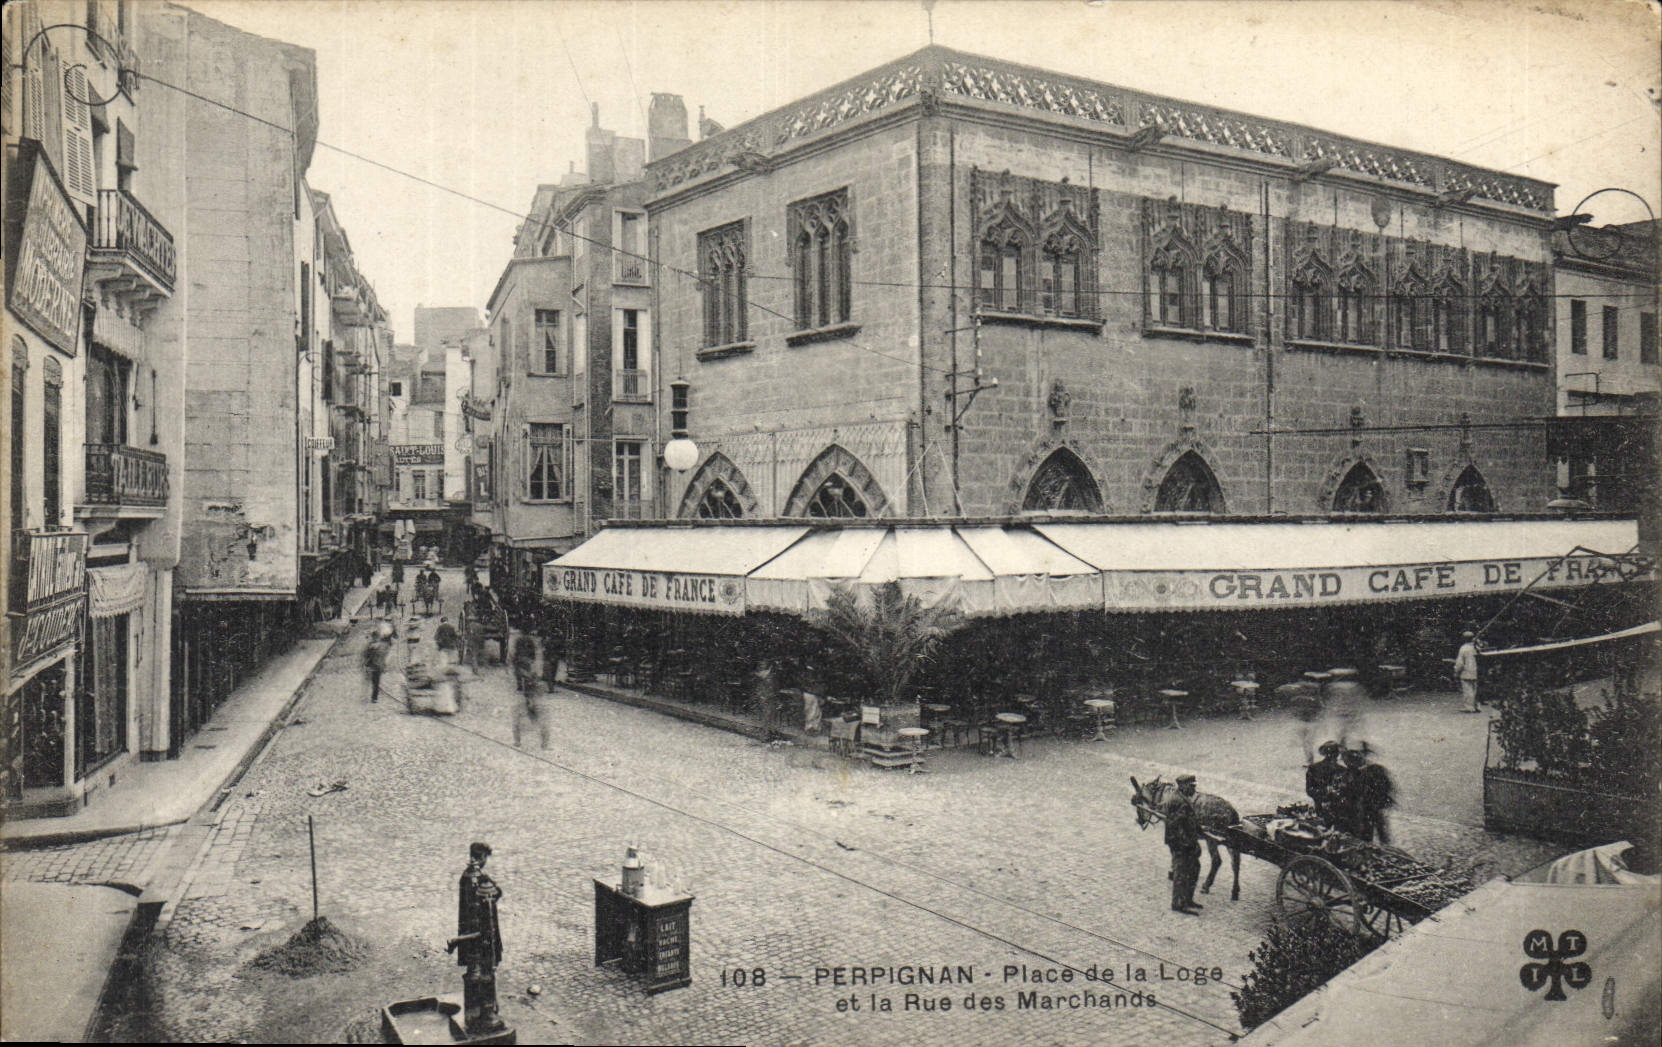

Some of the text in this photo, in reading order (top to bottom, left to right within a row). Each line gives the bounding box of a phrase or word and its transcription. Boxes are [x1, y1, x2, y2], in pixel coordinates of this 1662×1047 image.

[16, 237, 76, 336] MODERNE
[308, 438, 334, 449] COIFFEUR
[564, 571, 597, 592] GRAND
[642, 576, 657, 598] DE
[666, 579, 716, 603] FRANCE
[1208, 572, 1343, 600] GRAND
[1483, 562, 1522, 586] DE
[660, 921, 677, 932] LAIT
